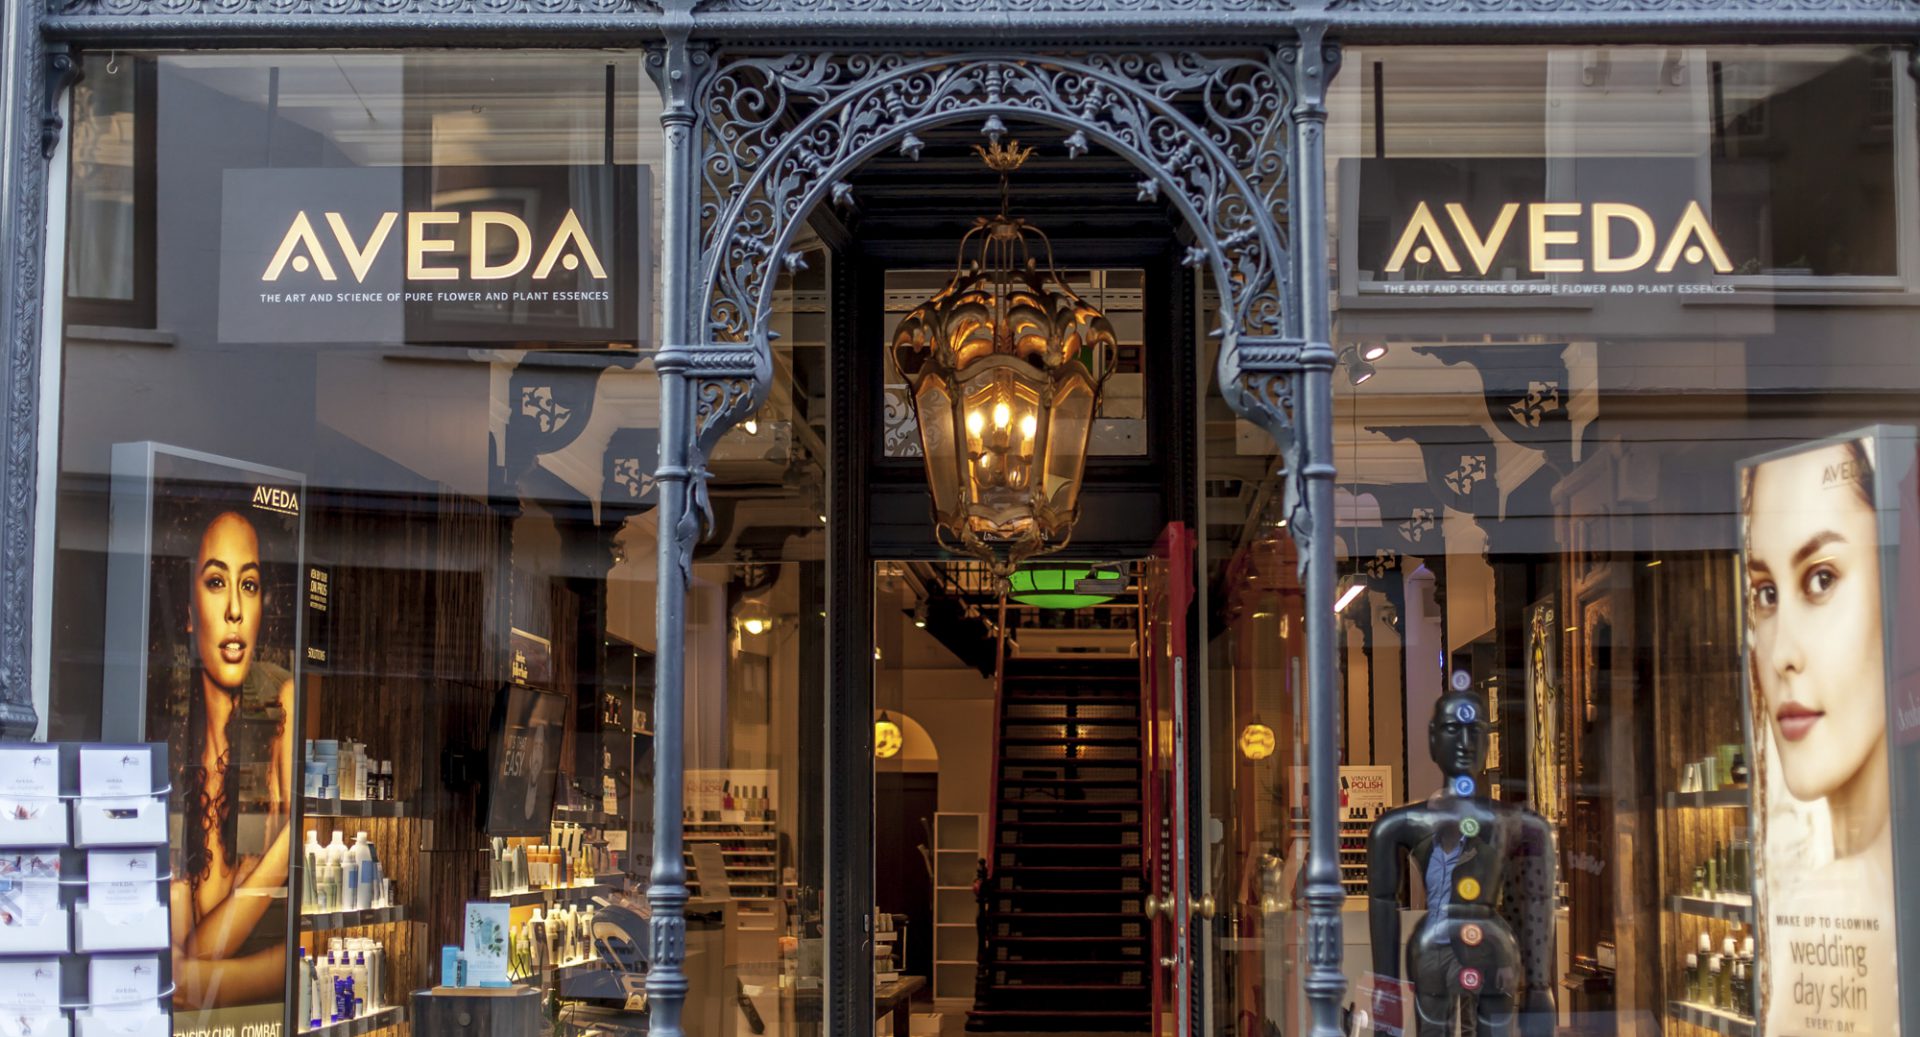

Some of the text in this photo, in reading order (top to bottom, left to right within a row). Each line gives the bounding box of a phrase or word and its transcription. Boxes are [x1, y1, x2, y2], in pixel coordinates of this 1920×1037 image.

[261, 208, 608, 284] AVEDA
[1384, 200, 1734, 275] AVEDA
[260, 291, 609, 303] THE ART AND SCIENCE OF PURE FLOWER AND PLANT ESSENCES
[1384, 284, 1735, 294] THE ART AND SCIENCE OF PURE FLOWER AND PLANT ESSENCES
[252, 485, 299, 511] AVEDA
[504, 751, 526, 777] EASY
[1776, 915, 1880, 931] WAKE UP TO GLOWING
[1790, 934, 1868, 977] wedding
[1793, 973, 1868, 1014] day skin
[241, 1022, 282, 1037] COMBAT
[1837, 1018, 1856, 1033] DAY
